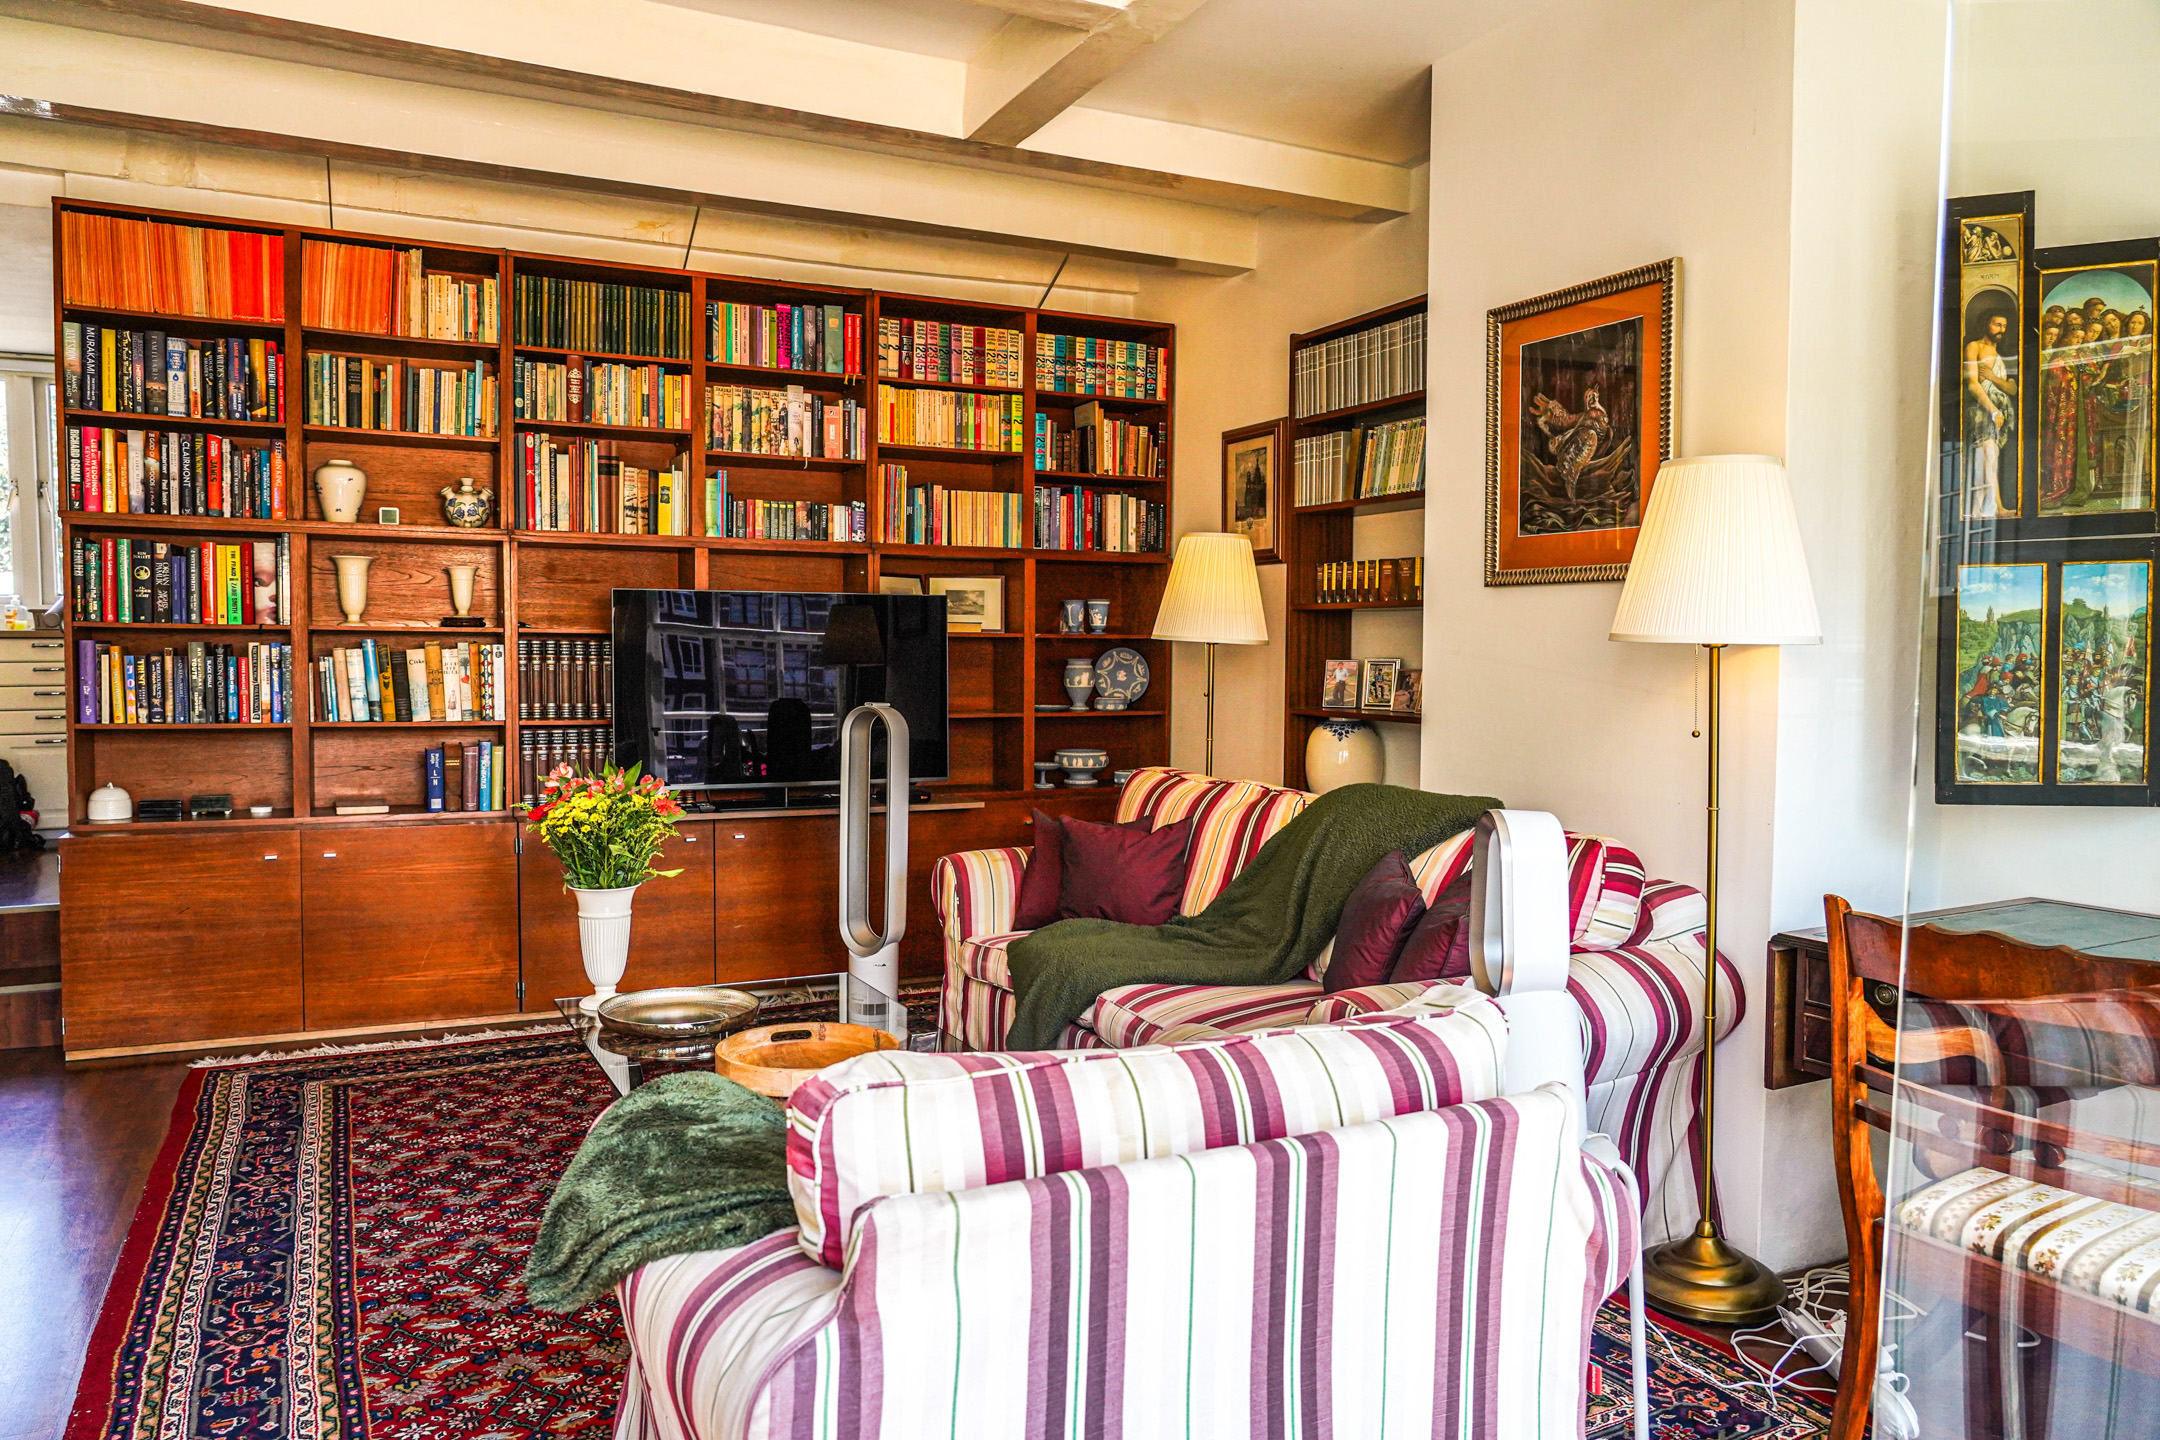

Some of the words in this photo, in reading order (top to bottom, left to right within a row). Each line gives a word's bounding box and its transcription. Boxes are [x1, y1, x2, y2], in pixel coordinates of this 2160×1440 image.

[86, 327, 95, 374] MURAKAMI
[785, 348, 790, 358] EN
[268, 355, 276, 386] ENTITLEMENT
[1147, 364, 1156, 389] 12345
[70, 429, 80, 458] RICHARD
[195, 437, 203, 452] The
[71, 459, 80, 482] OSMAN
[182, 441, 190, 487] CLAIRMONT
[195, 453, 203, 474] Actor
[73, 549, 83, 577] BEHOLDERS
[155, 562, 163, 586] PAMUK
[162, 562, 170, 586] ORHAN
[197, 648, 201, 656] AN
[137, 659, 145, 685] TRUST
